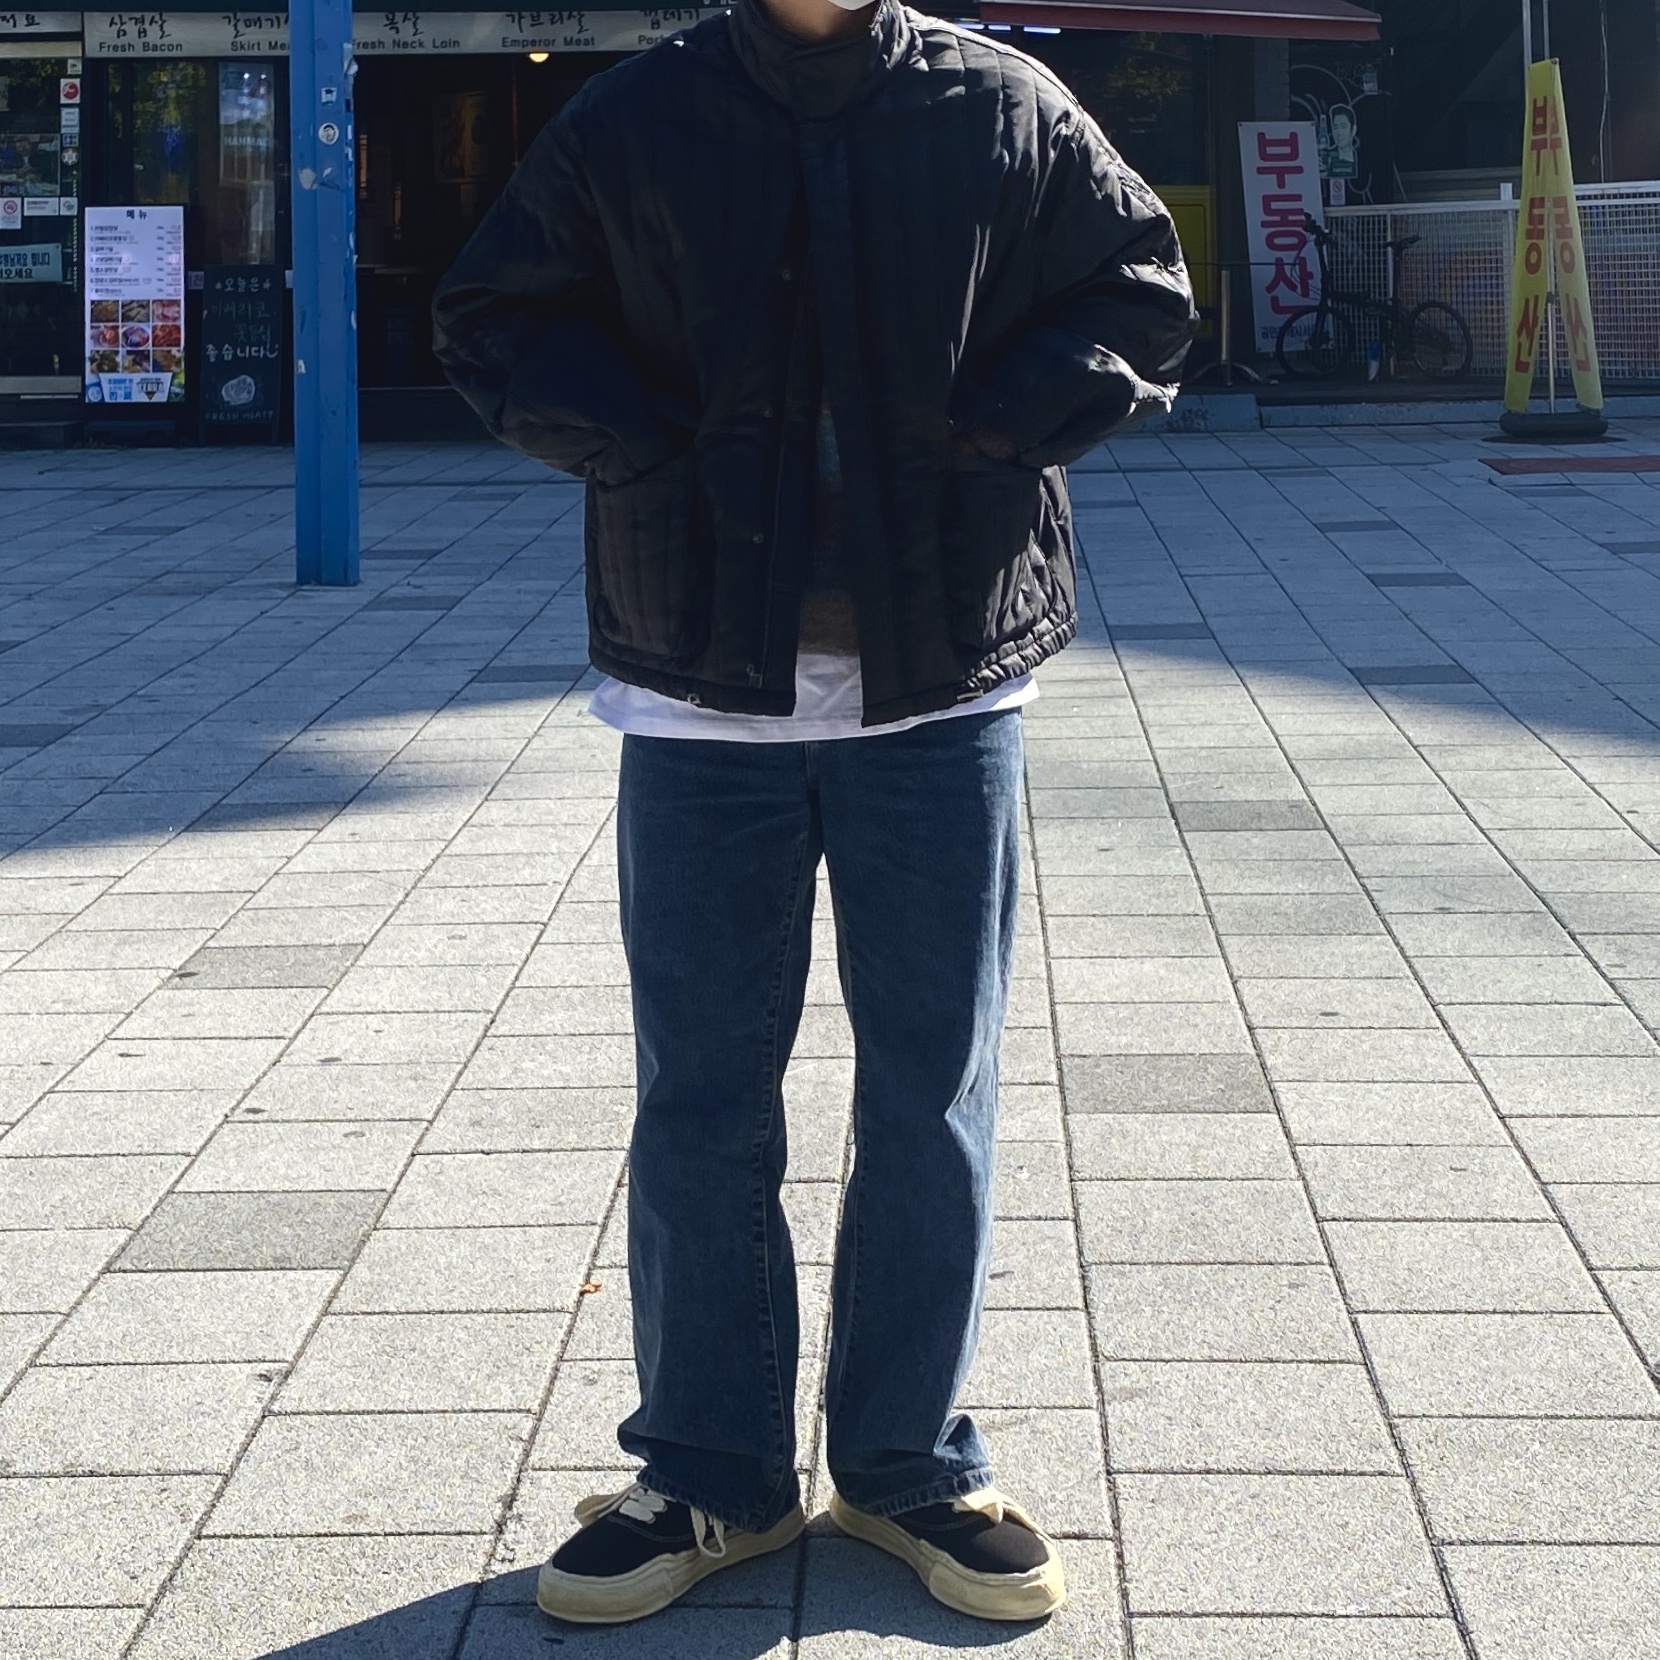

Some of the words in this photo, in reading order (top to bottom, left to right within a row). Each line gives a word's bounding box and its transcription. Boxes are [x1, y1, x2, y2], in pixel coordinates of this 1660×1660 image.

[108, 13, 172, 39] 삼겹살
[221, 12, 290, 39] 갈매기
[383, 11, 424, 37] 목살
[506, 11, 590, 36] 가브리살
[99, 41, 135, 52] Fresh
[142, 41, 183, 52] Bacon
[230, 40, 262, 52] Skirt
[268, 40, 291, 51] Me
[392, 38, 425, 50] Neck
[432, 37, 461, 49] Loin
[501, 36, 556, 49] Emperor
[562, 35, 596, 48] Meat
[1255, 131, 1316, 315] 부동산
[1513, 95, 1548, 374] 부동산
[223, 276, 261, 293] 오늘은
[205, 342, 266, 363] 좋습니다
